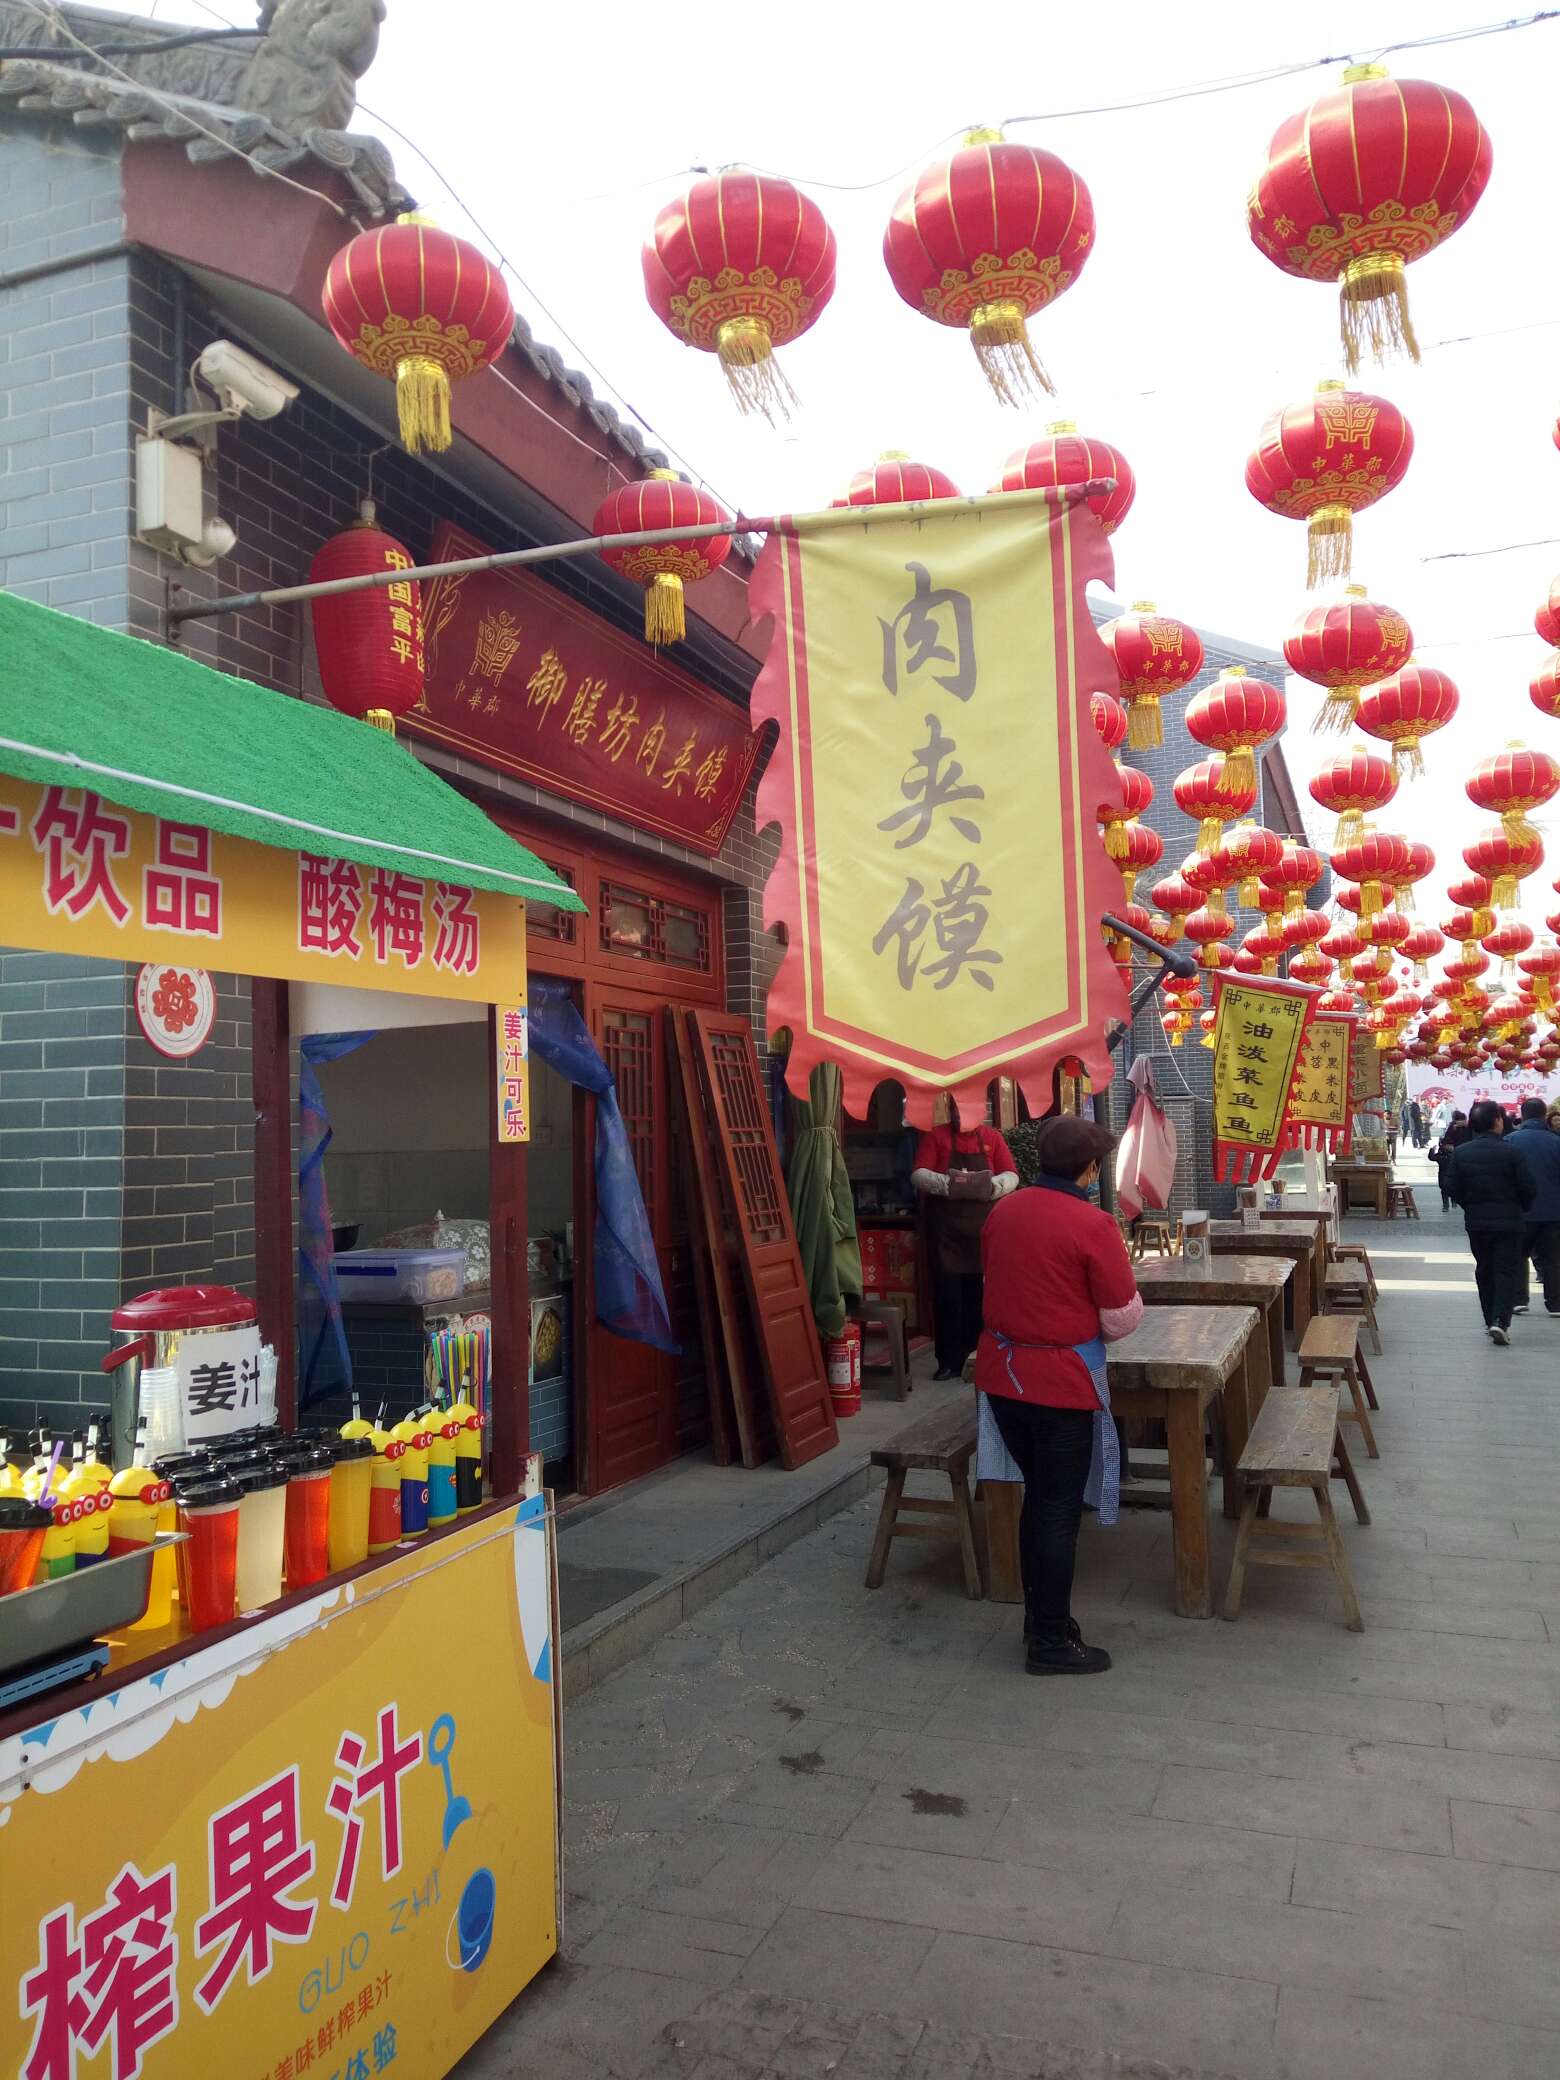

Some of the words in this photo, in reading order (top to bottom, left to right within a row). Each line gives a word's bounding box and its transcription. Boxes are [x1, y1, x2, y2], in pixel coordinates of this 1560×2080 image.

[384, 548, 414, 664] 中国富平
[872, 561, 1003, 992] 肉夹馍
[299, 852, 481, 975] 酸梅汤
[502, 1011, 526, 1139] 姜汁可乐
[188, 1354, 260, 1416] 姜汁
[20, 1702, 422, 2080] 榨果汁
[298, 1932, 370, 2014] GUO
[390, 1868, 441, 1934] ZHI
[261, 1968, 393, 2080] 美味鲜榨果汁
